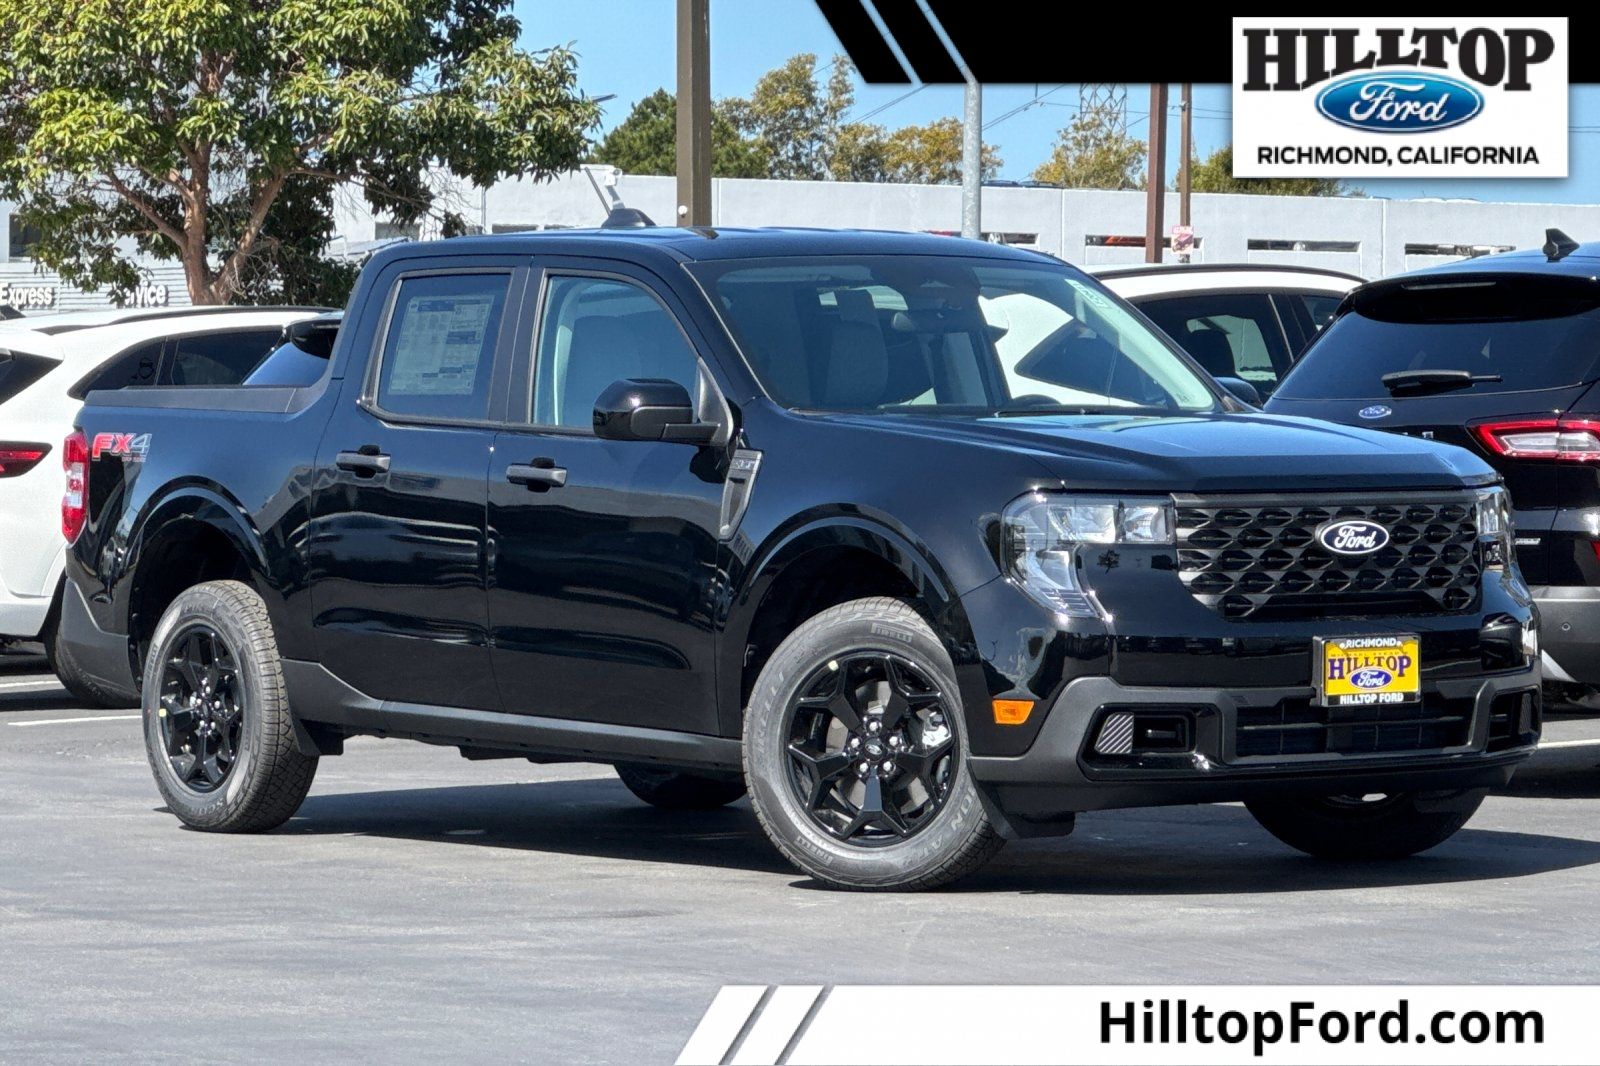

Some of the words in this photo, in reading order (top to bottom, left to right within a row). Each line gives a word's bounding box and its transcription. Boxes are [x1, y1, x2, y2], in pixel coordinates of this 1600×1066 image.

[0, 283, 53, 309] Express
[91, 432, 152, 462] FX4
[1333, 526, 1378, 549] Ford
[1345, 637, 1397, 649] RICHMOND
[1328, 655, 1412, 680] HILLTOP
[1357, 670, 1385, 687] Ford
[1340, 693, 1378, 705] HILLTOP
[1379, 692, 1404, 703] FORD
